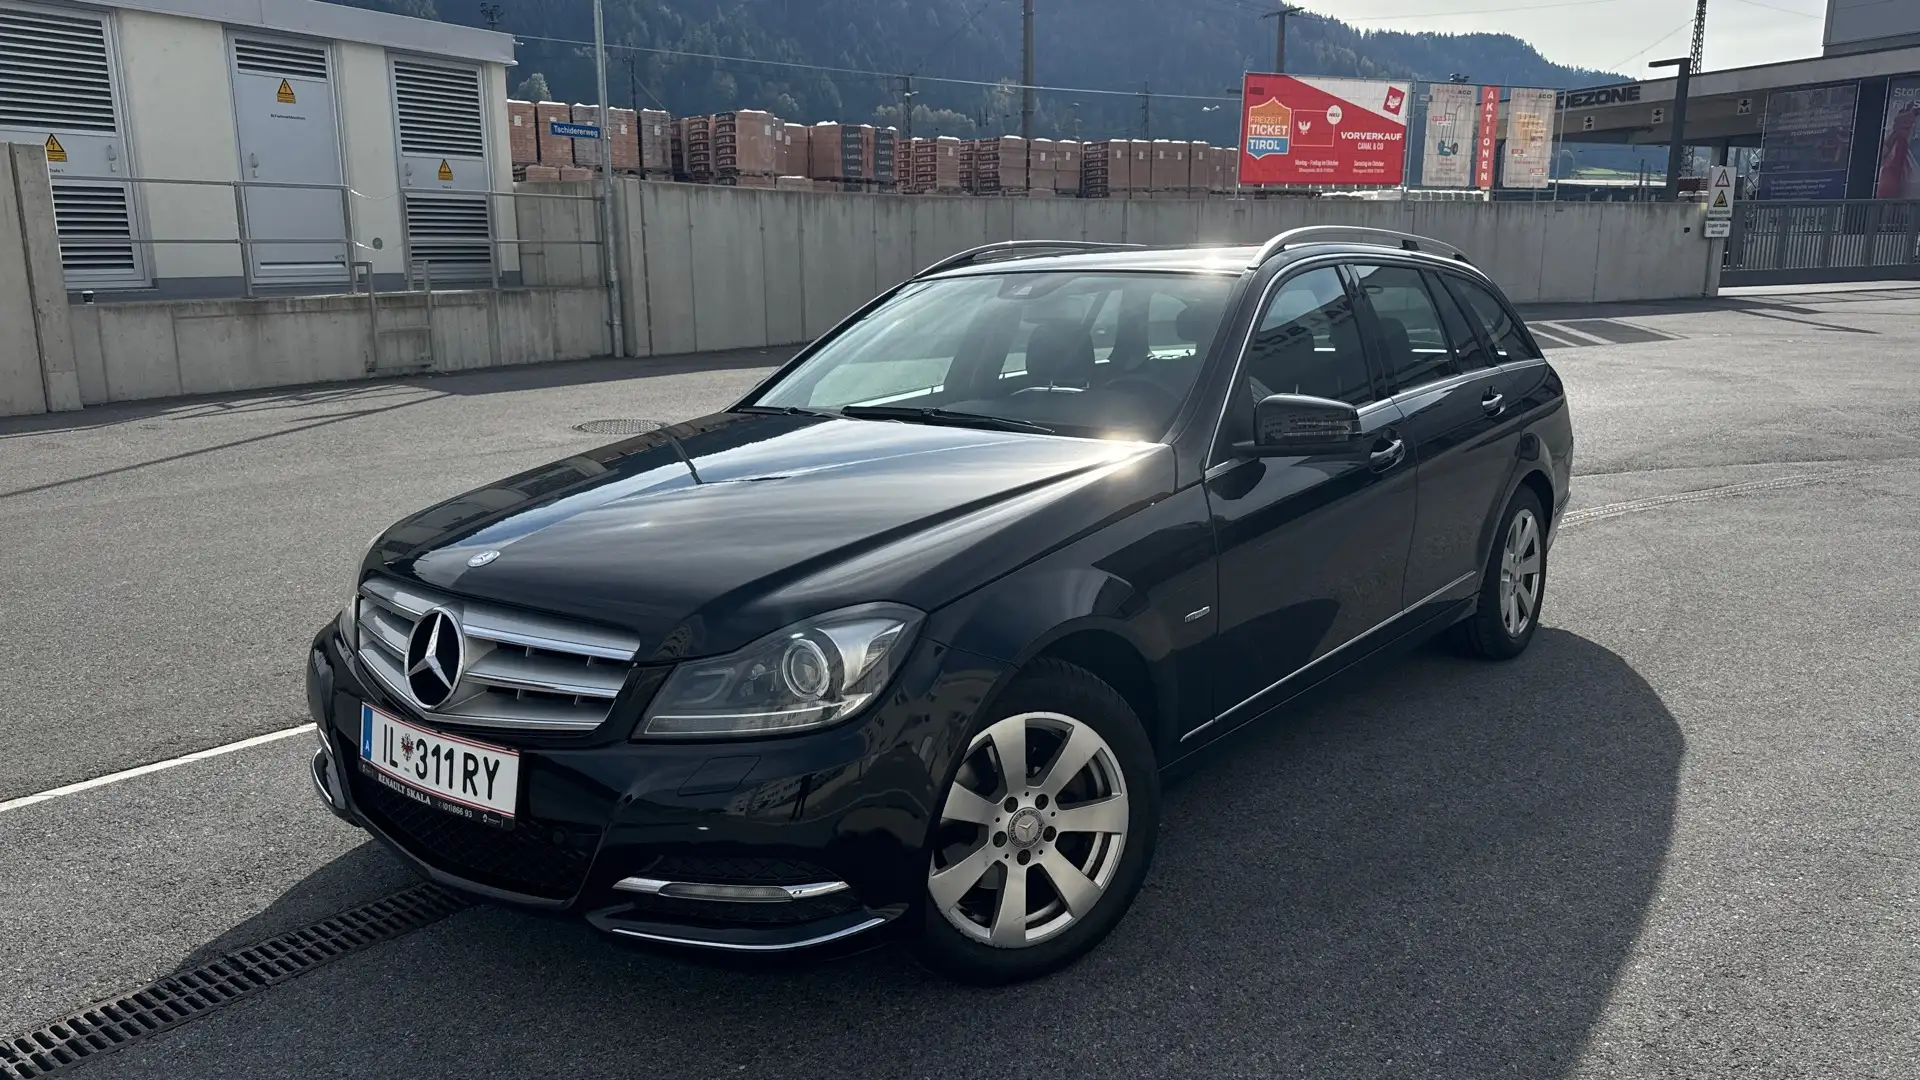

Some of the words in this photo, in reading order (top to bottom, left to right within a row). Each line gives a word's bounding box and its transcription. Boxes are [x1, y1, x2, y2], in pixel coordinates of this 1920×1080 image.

[1250, 115, 1283, 124] FREIZEIT
[553, 125, 598, 138] Tschidererweg
[1250, 124, 1288, 135] TICKET
[1340, 131, 1402, 140] VORVERKAUF
[1480, 90, 1494, 181] AKTIONEN
[1249, 139, 1280, 150] TIROL
[1357, 142, 1372, 150] CANAL
[1376, 142, 1384, 150] CO
[364, 740, 370, 751] A
[383, 724, 398, 768] IL
[378, 773, 405, 795] RENAULT
[406, 787, 432, 805] SKALA
[464, 809, 473, 818] 93
